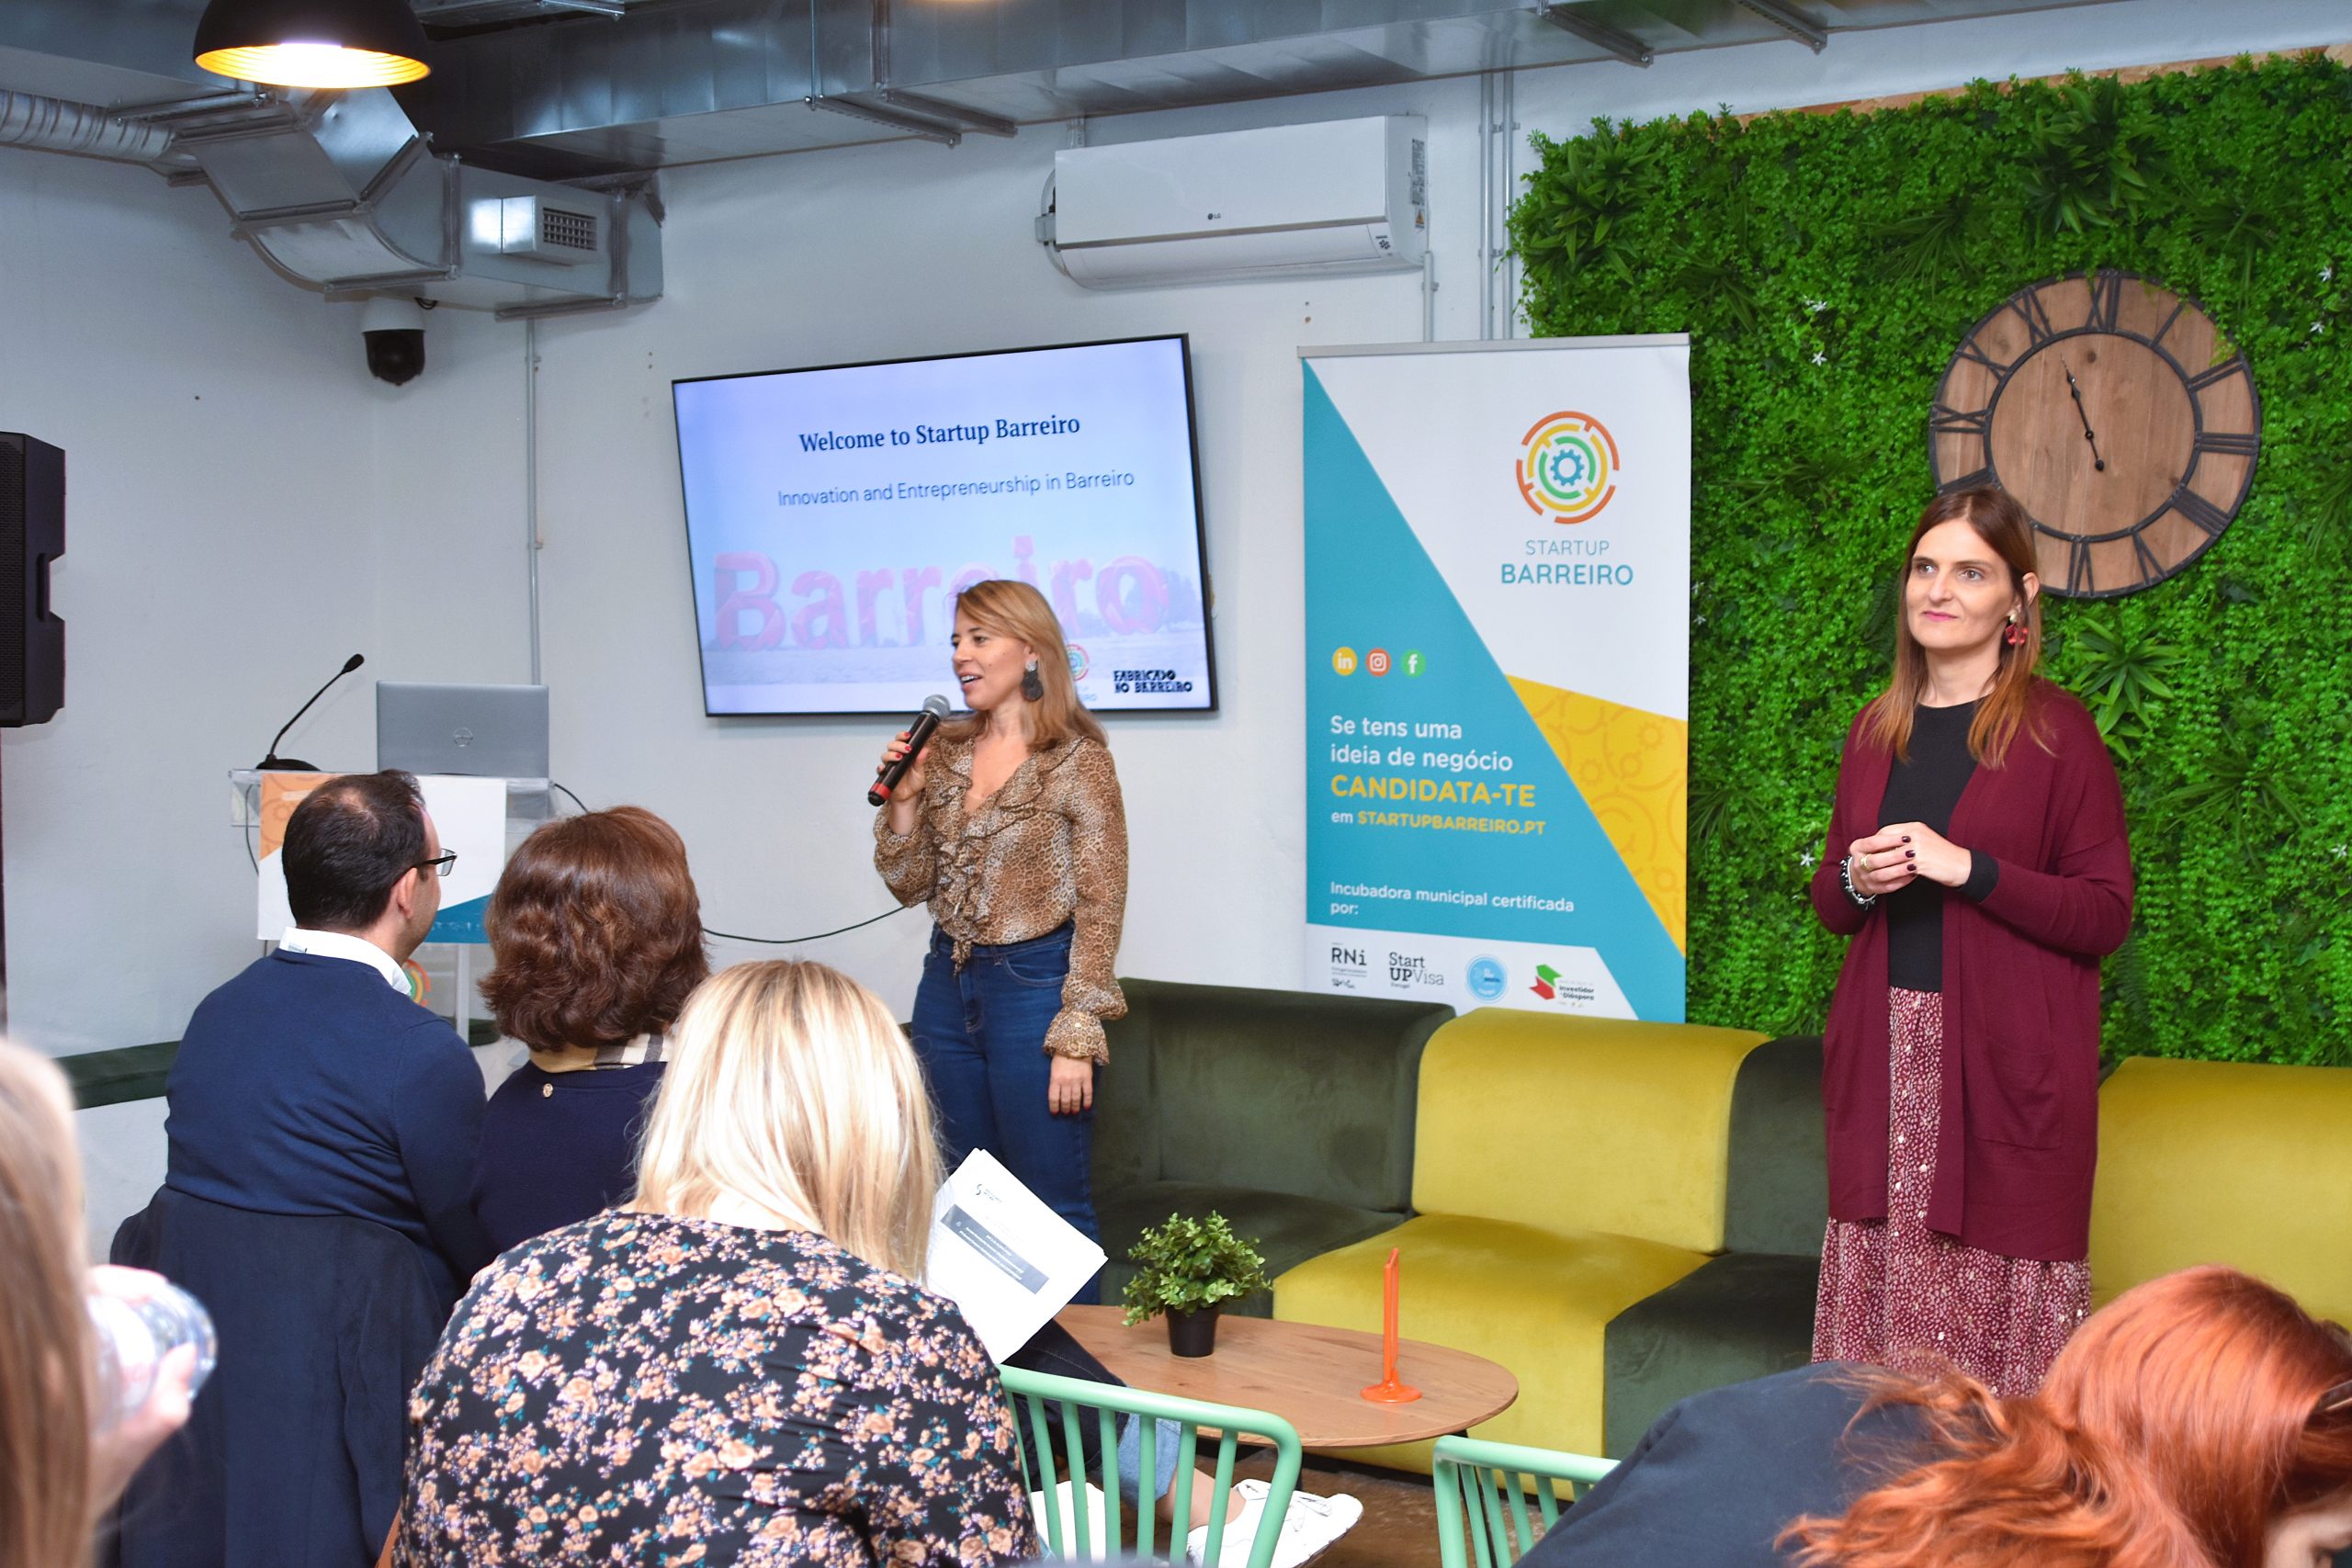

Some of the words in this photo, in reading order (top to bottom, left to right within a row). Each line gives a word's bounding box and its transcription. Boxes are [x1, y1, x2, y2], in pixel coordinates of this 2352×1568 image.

[798, 430, 885, 453] Welcome
[891, 428, 910, 446] to
[917, 423, 989, 445] Startup
[995, 415, 1080, 438] Barreiro
[778, 485, 859, 506] Innovation
[864, 483, 893, 502] and
[899, 475, 1041, 502] Entrepreneurship
[1046, 474, 1061, 491] in
[1066, 469, 1135, 489] Barreiro
[1525, 540, 1610, 556] STARTUP
[1501, 564, 1634, 586] BARREIRO
[714, 535, 1170, 650] Barriro
[1114, 682, 1130, 693] NO
[1135, 682, 1193, 693] BARREIRO
[1330, 715, 1355, 735] Se
[1362, 717, 1408, 738] tens
[1415, 721, 1463, 739] uma
[1330, 744, 1381, 765] ideia
[1387, 747, 1416, 766] de
[1422, 749, 1513, 773] negócio
[1331, 773, 1536, 808] CANDIDATA-TE
[1331, 812, 1353, 824] em
[1358, 810, 1546, 835] STARTUPBARREIRO.PT
[1330, 882, 1412, 901] Incubadora
[1416, 888, 1488, 908] municipal
[1492, 895, 1575, 913] certificada
[1330, 901, 1359, 917] por:
[1331, 947, 1367, 966] RNi
[1388, 952, 1426, 968] Start
[1389, 967, 1445, 986] UPVisa
